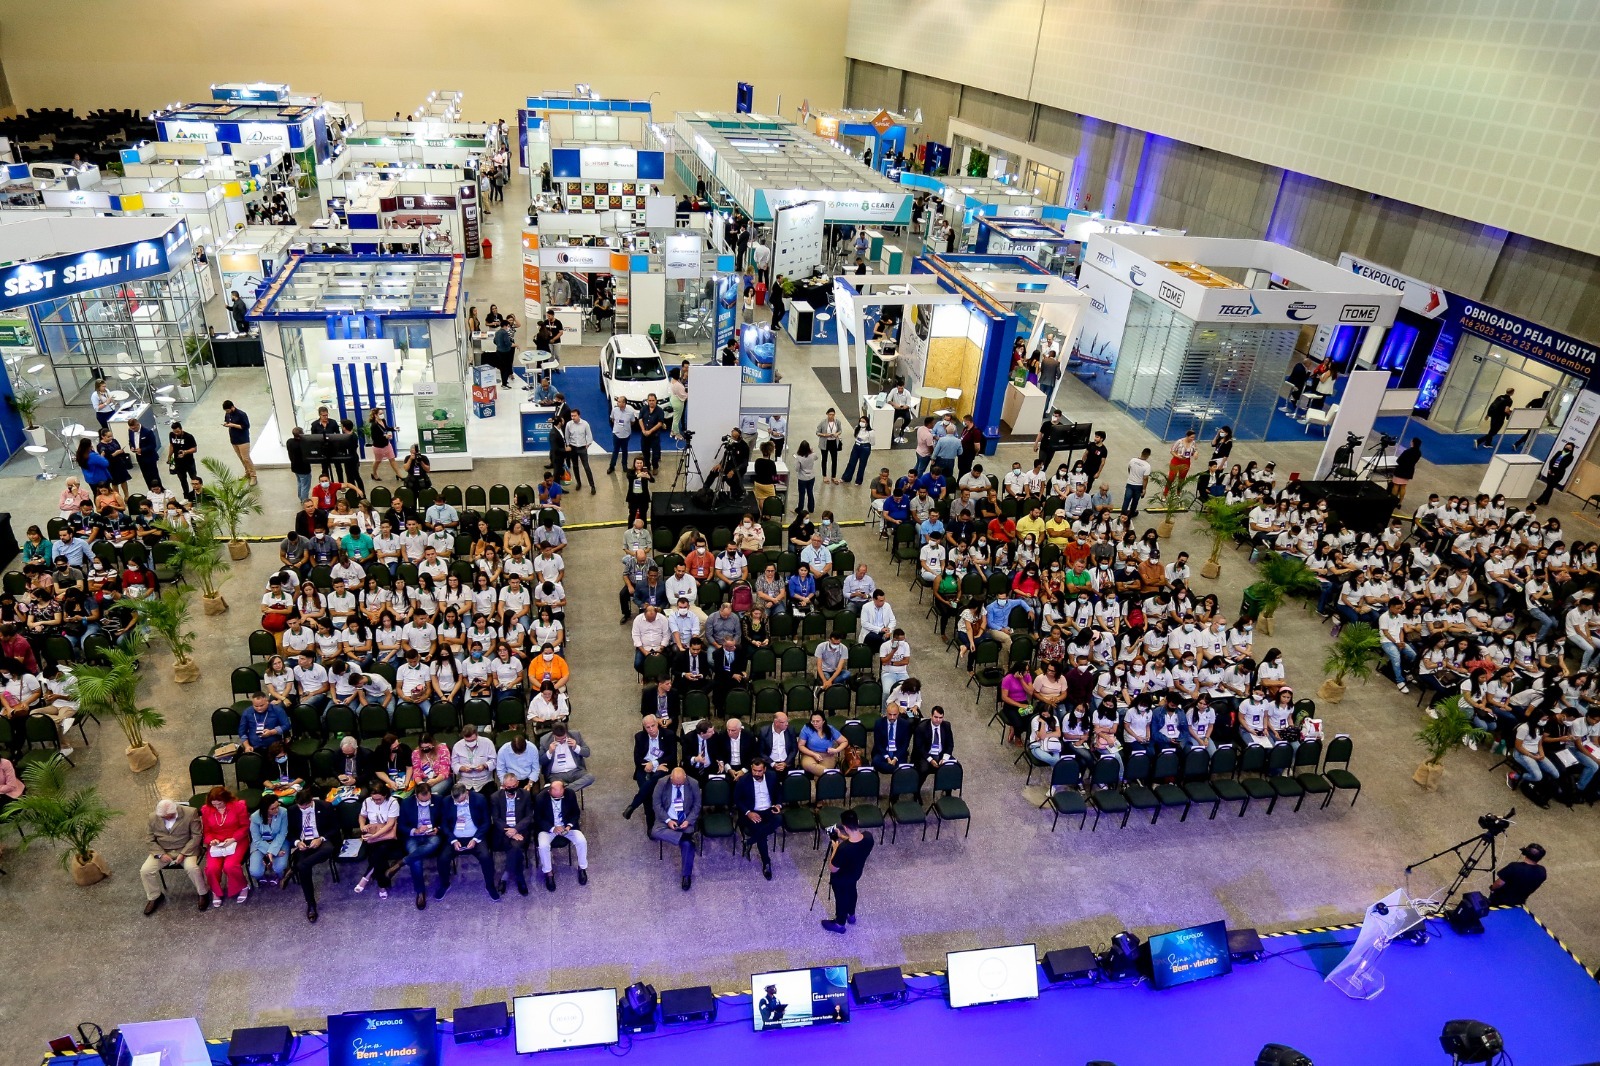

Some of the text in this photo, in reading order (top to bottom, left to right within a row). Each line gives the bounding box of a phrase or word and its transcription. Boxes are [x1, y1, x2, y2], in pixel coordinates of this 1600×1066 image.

[871, 201, 895, 209] CEARÁ
[63, 257, 122, 284] SENAT
[4, 269, 56, 297] SEST
[1362, 266, 1406, 292] EXPOLOG
[1218, 304, 1253, 315] TECER
[1345, 308, 1376, 319] TOMÉ
[1464, 305, 1597, 364] OBRIGADO PELA VISITA
[1460, 316, 1474, 328] Até
[1501, 332, 1511, 343] 22
[1532, 345, 1543, 356] de
[1545, 350, 1591, 374] novembro
[742, 365, 762, 379] ENERGIA
[1172, 957, 1218, 973] Bem vindos
[375, 1019, 403, 1027] EXPOLOG
[356, 1048, 417, 1060] Bem vindos
